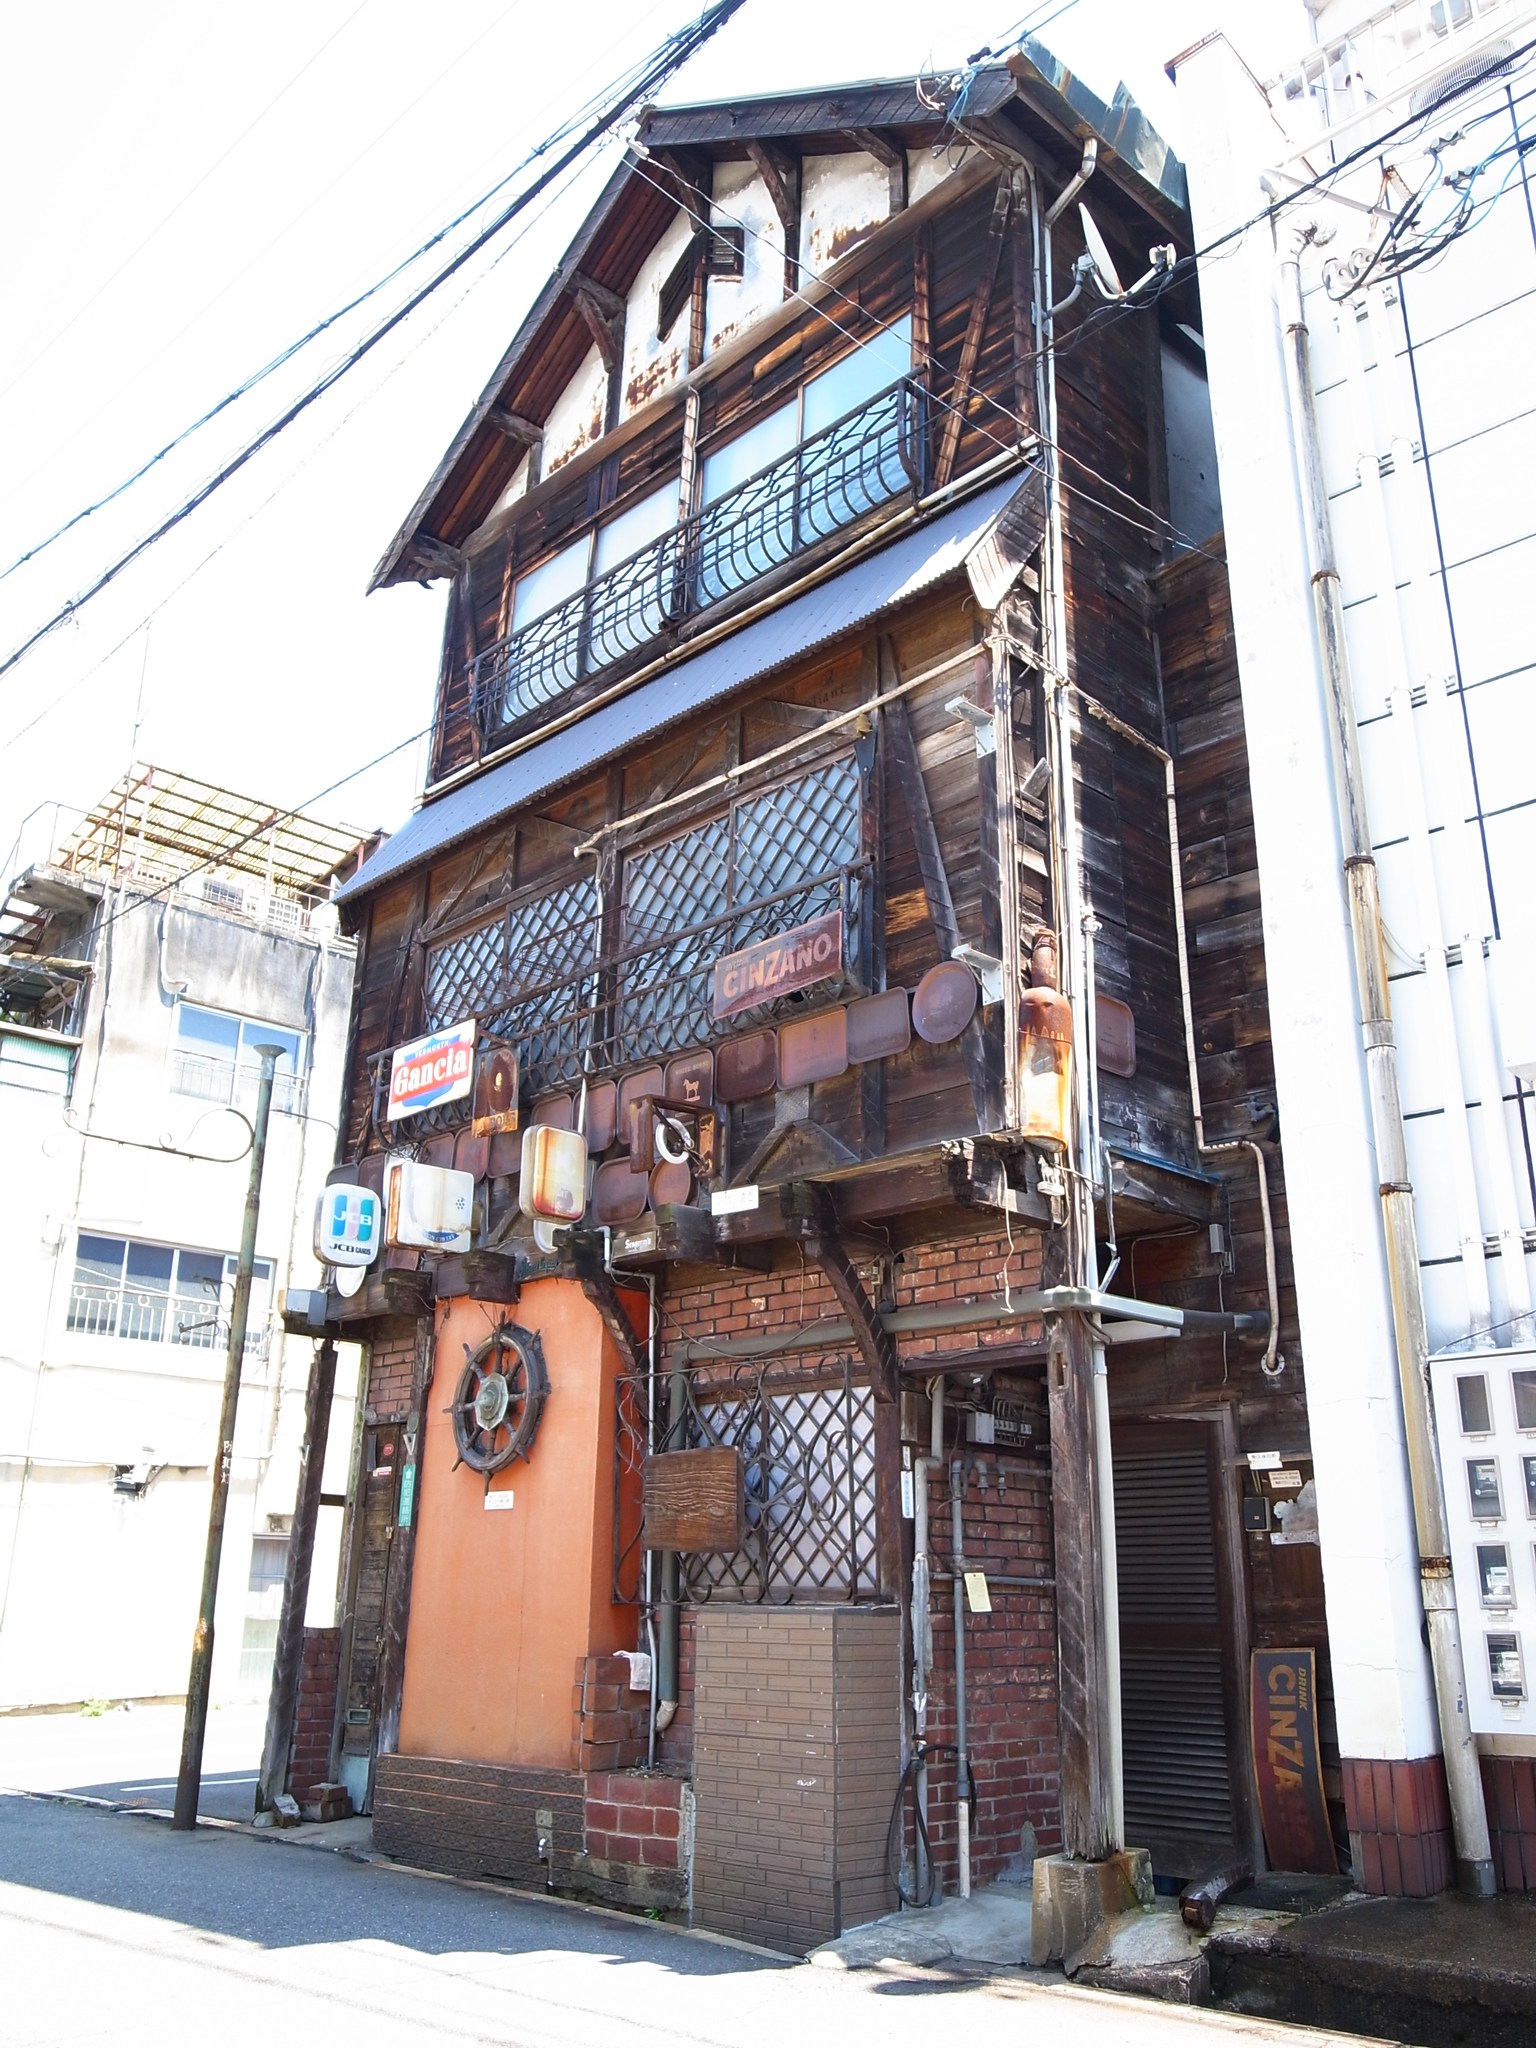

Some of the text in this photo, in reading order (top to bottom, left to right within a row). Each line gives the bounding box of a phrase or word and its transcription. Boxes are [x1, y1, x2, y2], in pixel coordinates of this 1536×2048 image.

[723, 933, 832, 998] CINZANO
[393, 1047, 468, 1097] Gancia
[334, 1210, 372, 1226] JCB
[329, 1243, 371, 1256] JCB CARDS
[1298, 1667, 1308, 1711] DRINK
